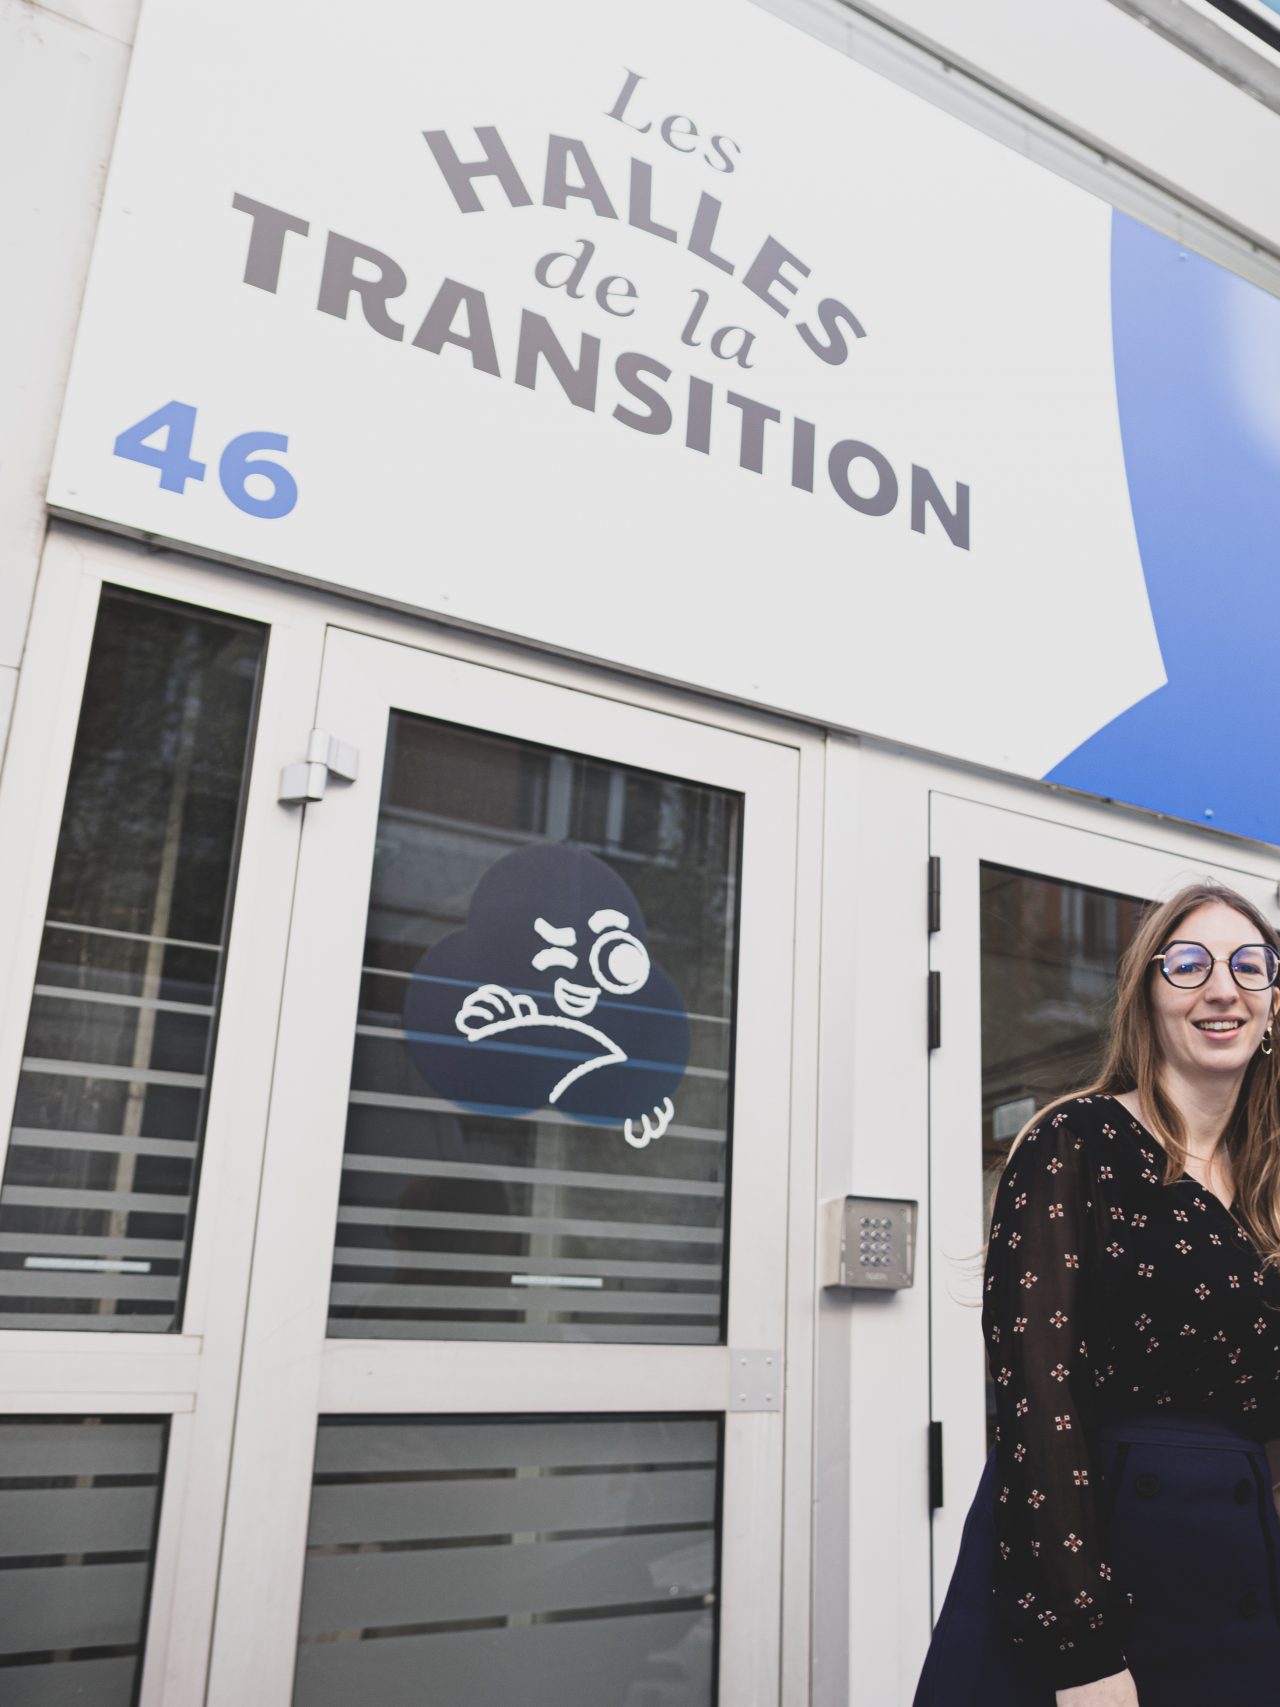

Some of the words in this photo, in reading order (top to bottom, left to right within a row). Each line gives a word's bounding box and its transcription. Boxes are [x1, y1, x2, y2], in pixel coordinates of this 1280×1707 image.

[602, 66, 742, 174] Les
[421, 125, 868, 366] HALLES
[533, 238, 640, 318] de
[679, 288, 757, 370] la
[231, 191, 971, 552] TRANSITION
[112, 400, 299, 520] 46
